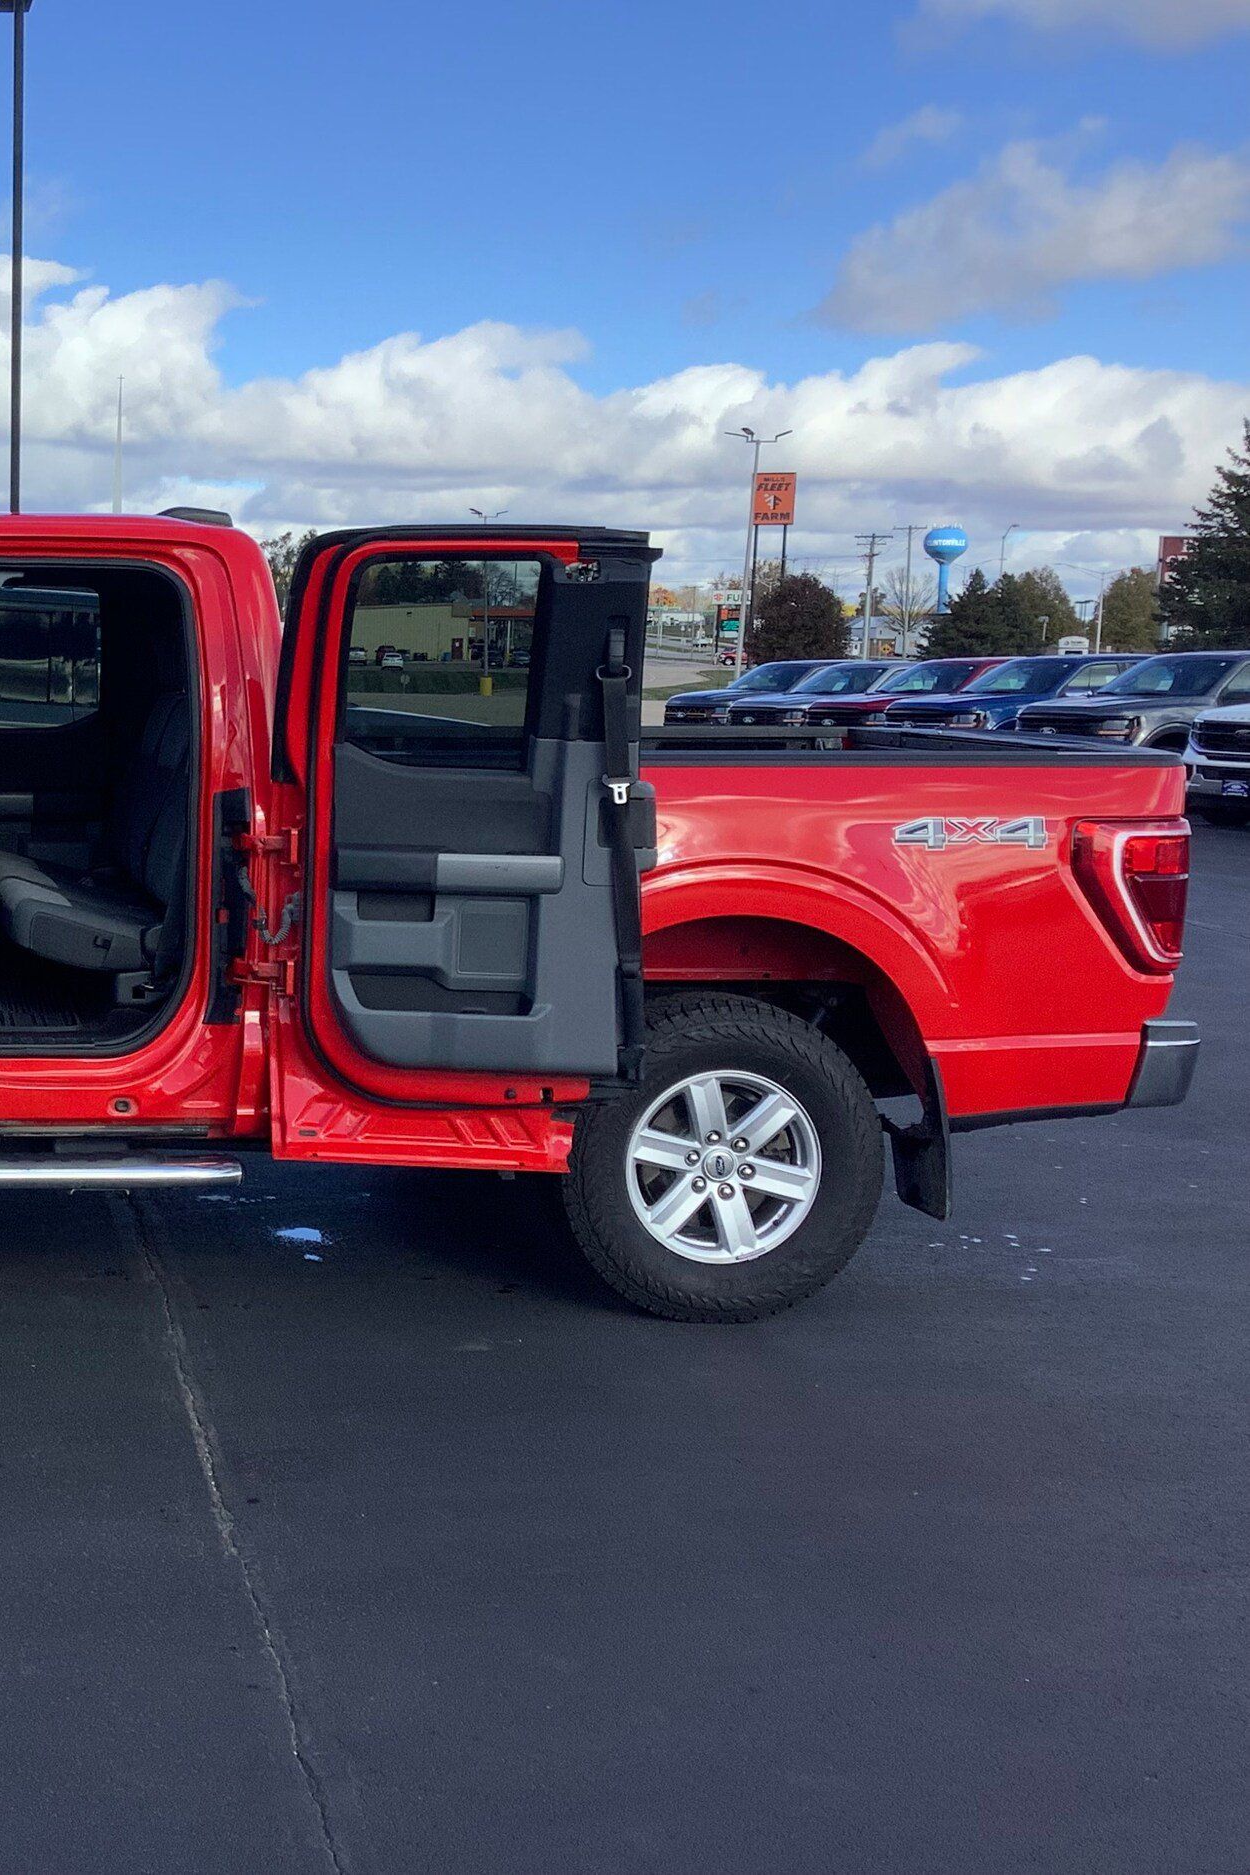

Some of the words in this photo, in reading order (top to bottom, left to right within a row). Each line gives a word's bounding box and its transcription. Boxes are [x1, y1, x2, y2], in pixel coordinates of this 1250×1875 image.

[756, 483, 791, 491] FLEET
[754, 512, 790, 521] FARM
[726, 593, 751, 601] FUL
